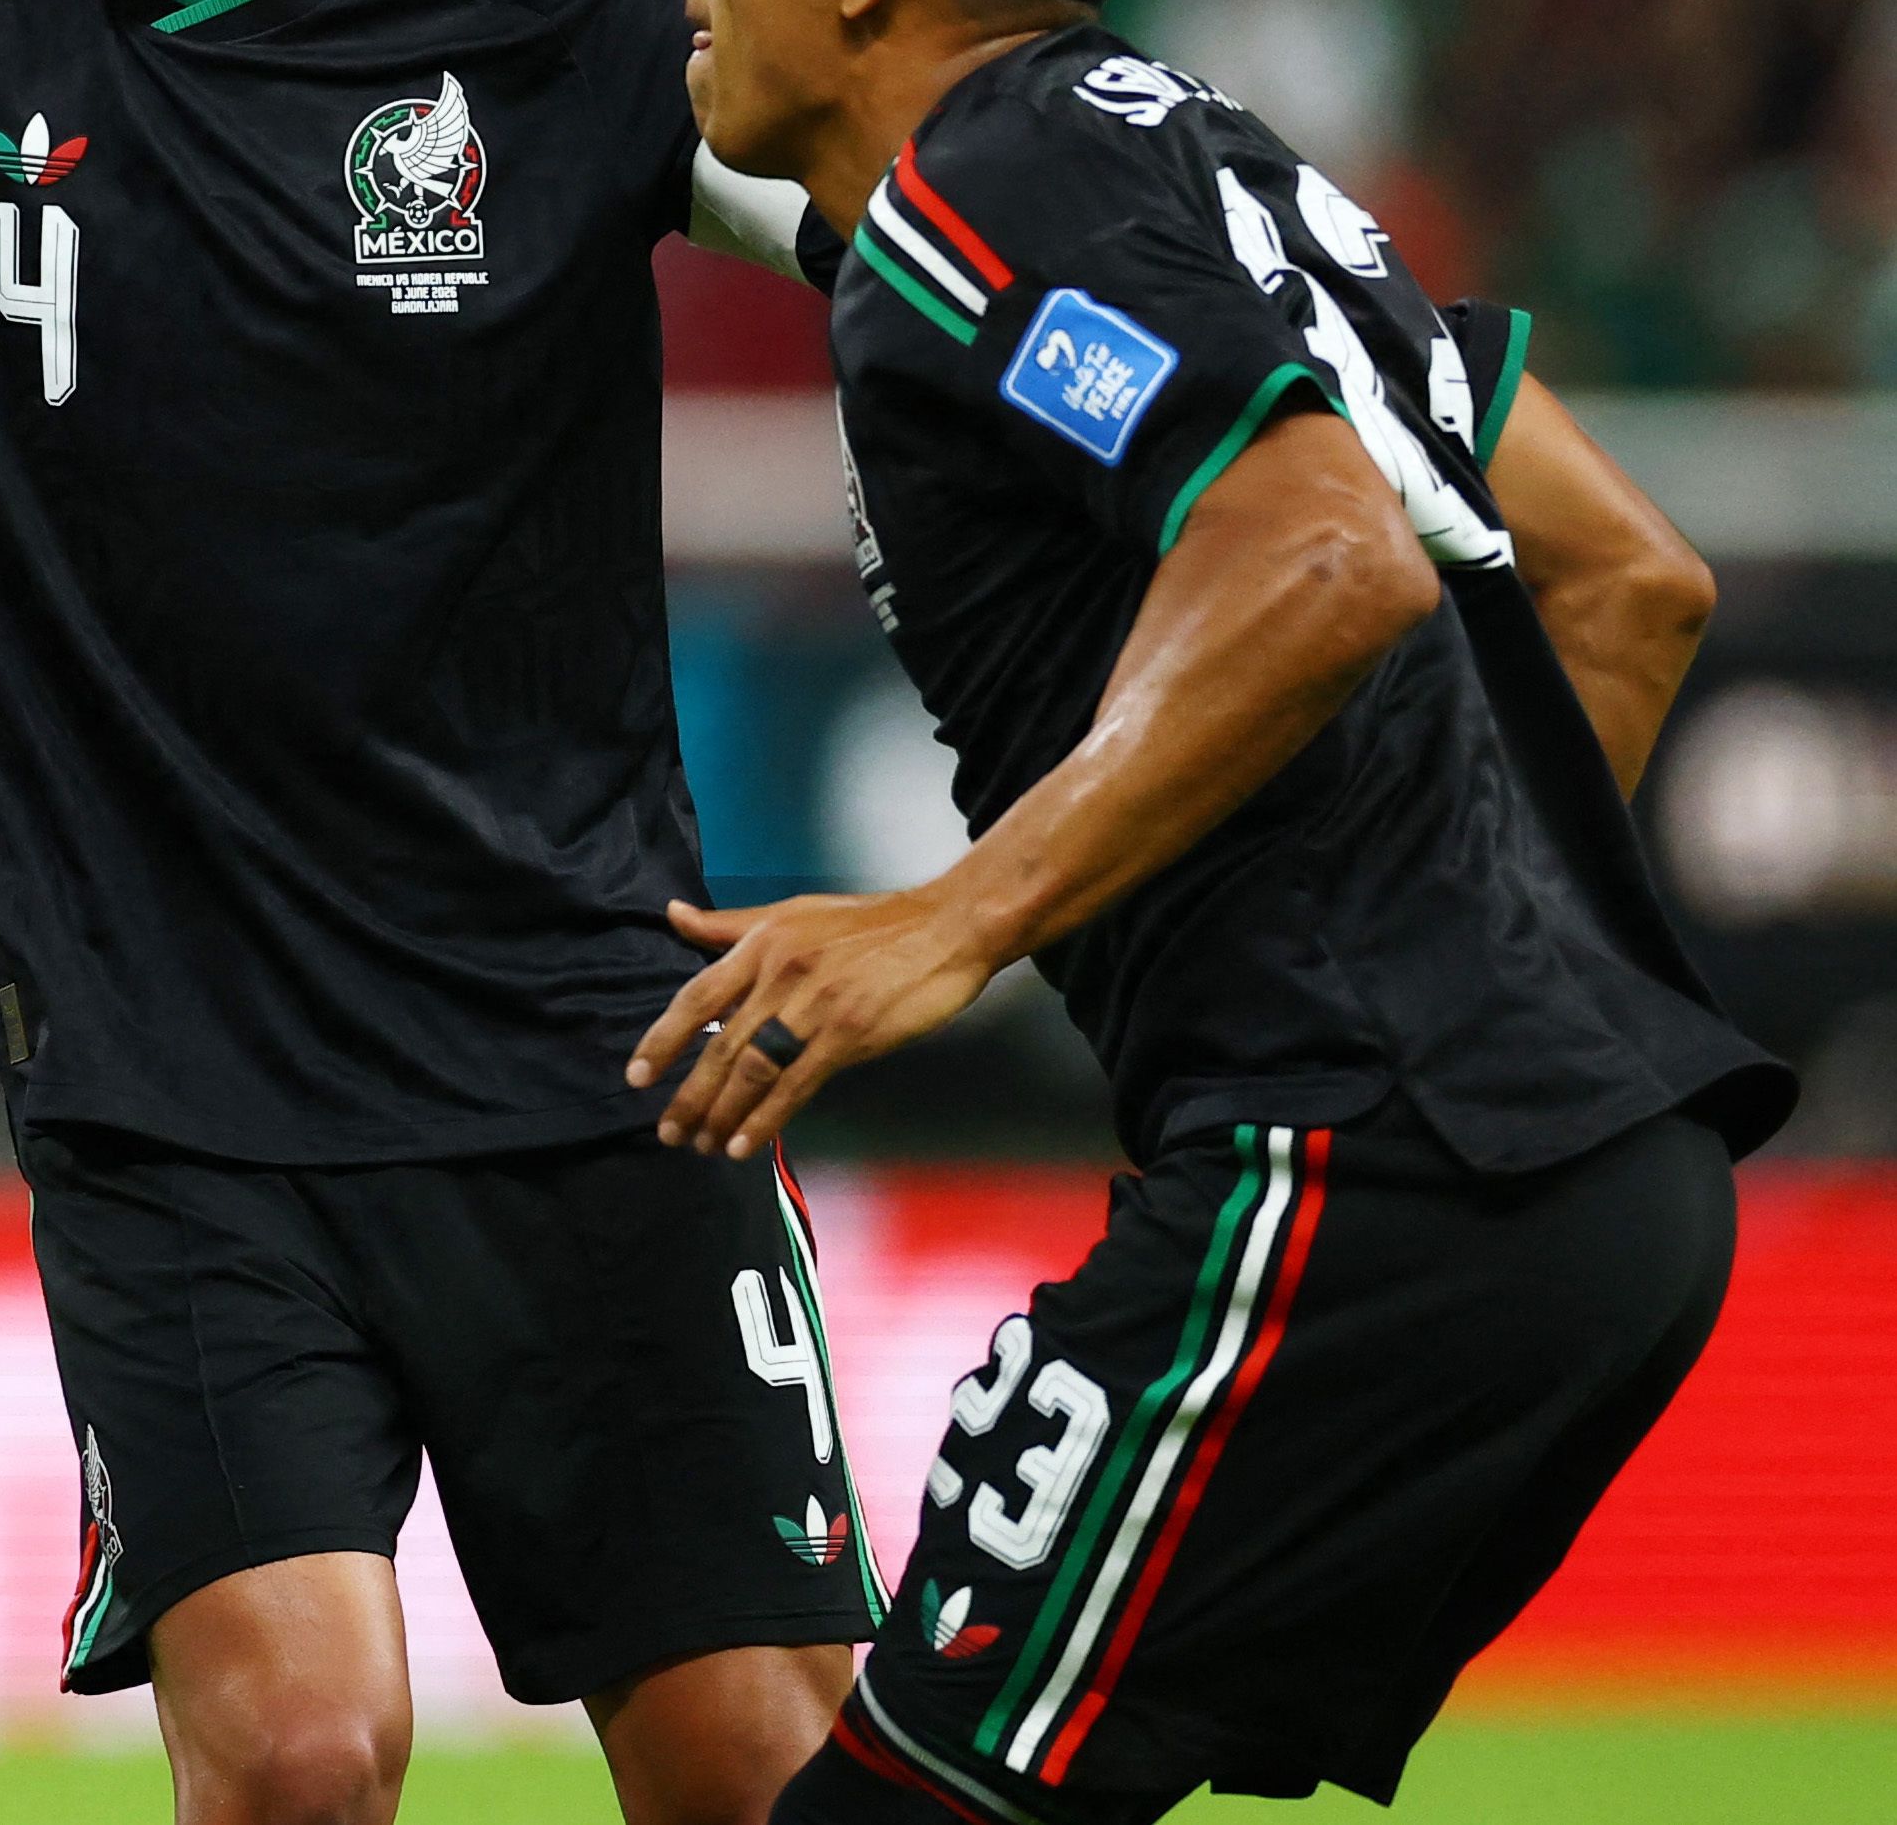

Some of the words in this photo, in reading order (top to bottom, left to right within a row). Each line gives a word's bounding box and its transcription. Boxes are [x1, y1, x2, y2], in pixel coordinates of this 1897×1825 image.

[361, 226, 478, 256] MÉXICO
[357, 274, 394, 287] MEXICO
[396, 274, 409, 286] VS
[411, 272, 443, 286] KOREA
[444, 271, 490, 285] REPUBLIC
[391, 287, 403, 300] 18
[404, 286, 429, 299] JUNE
[431, 286, 458, 299] 2026
[391, 299, 459, 314] GUADALAJARA
[1082, 357, 1135, 421] PEACE
[731, 1265, 834, 1464] 4
[926, 1316, 1111, 1571] 23
